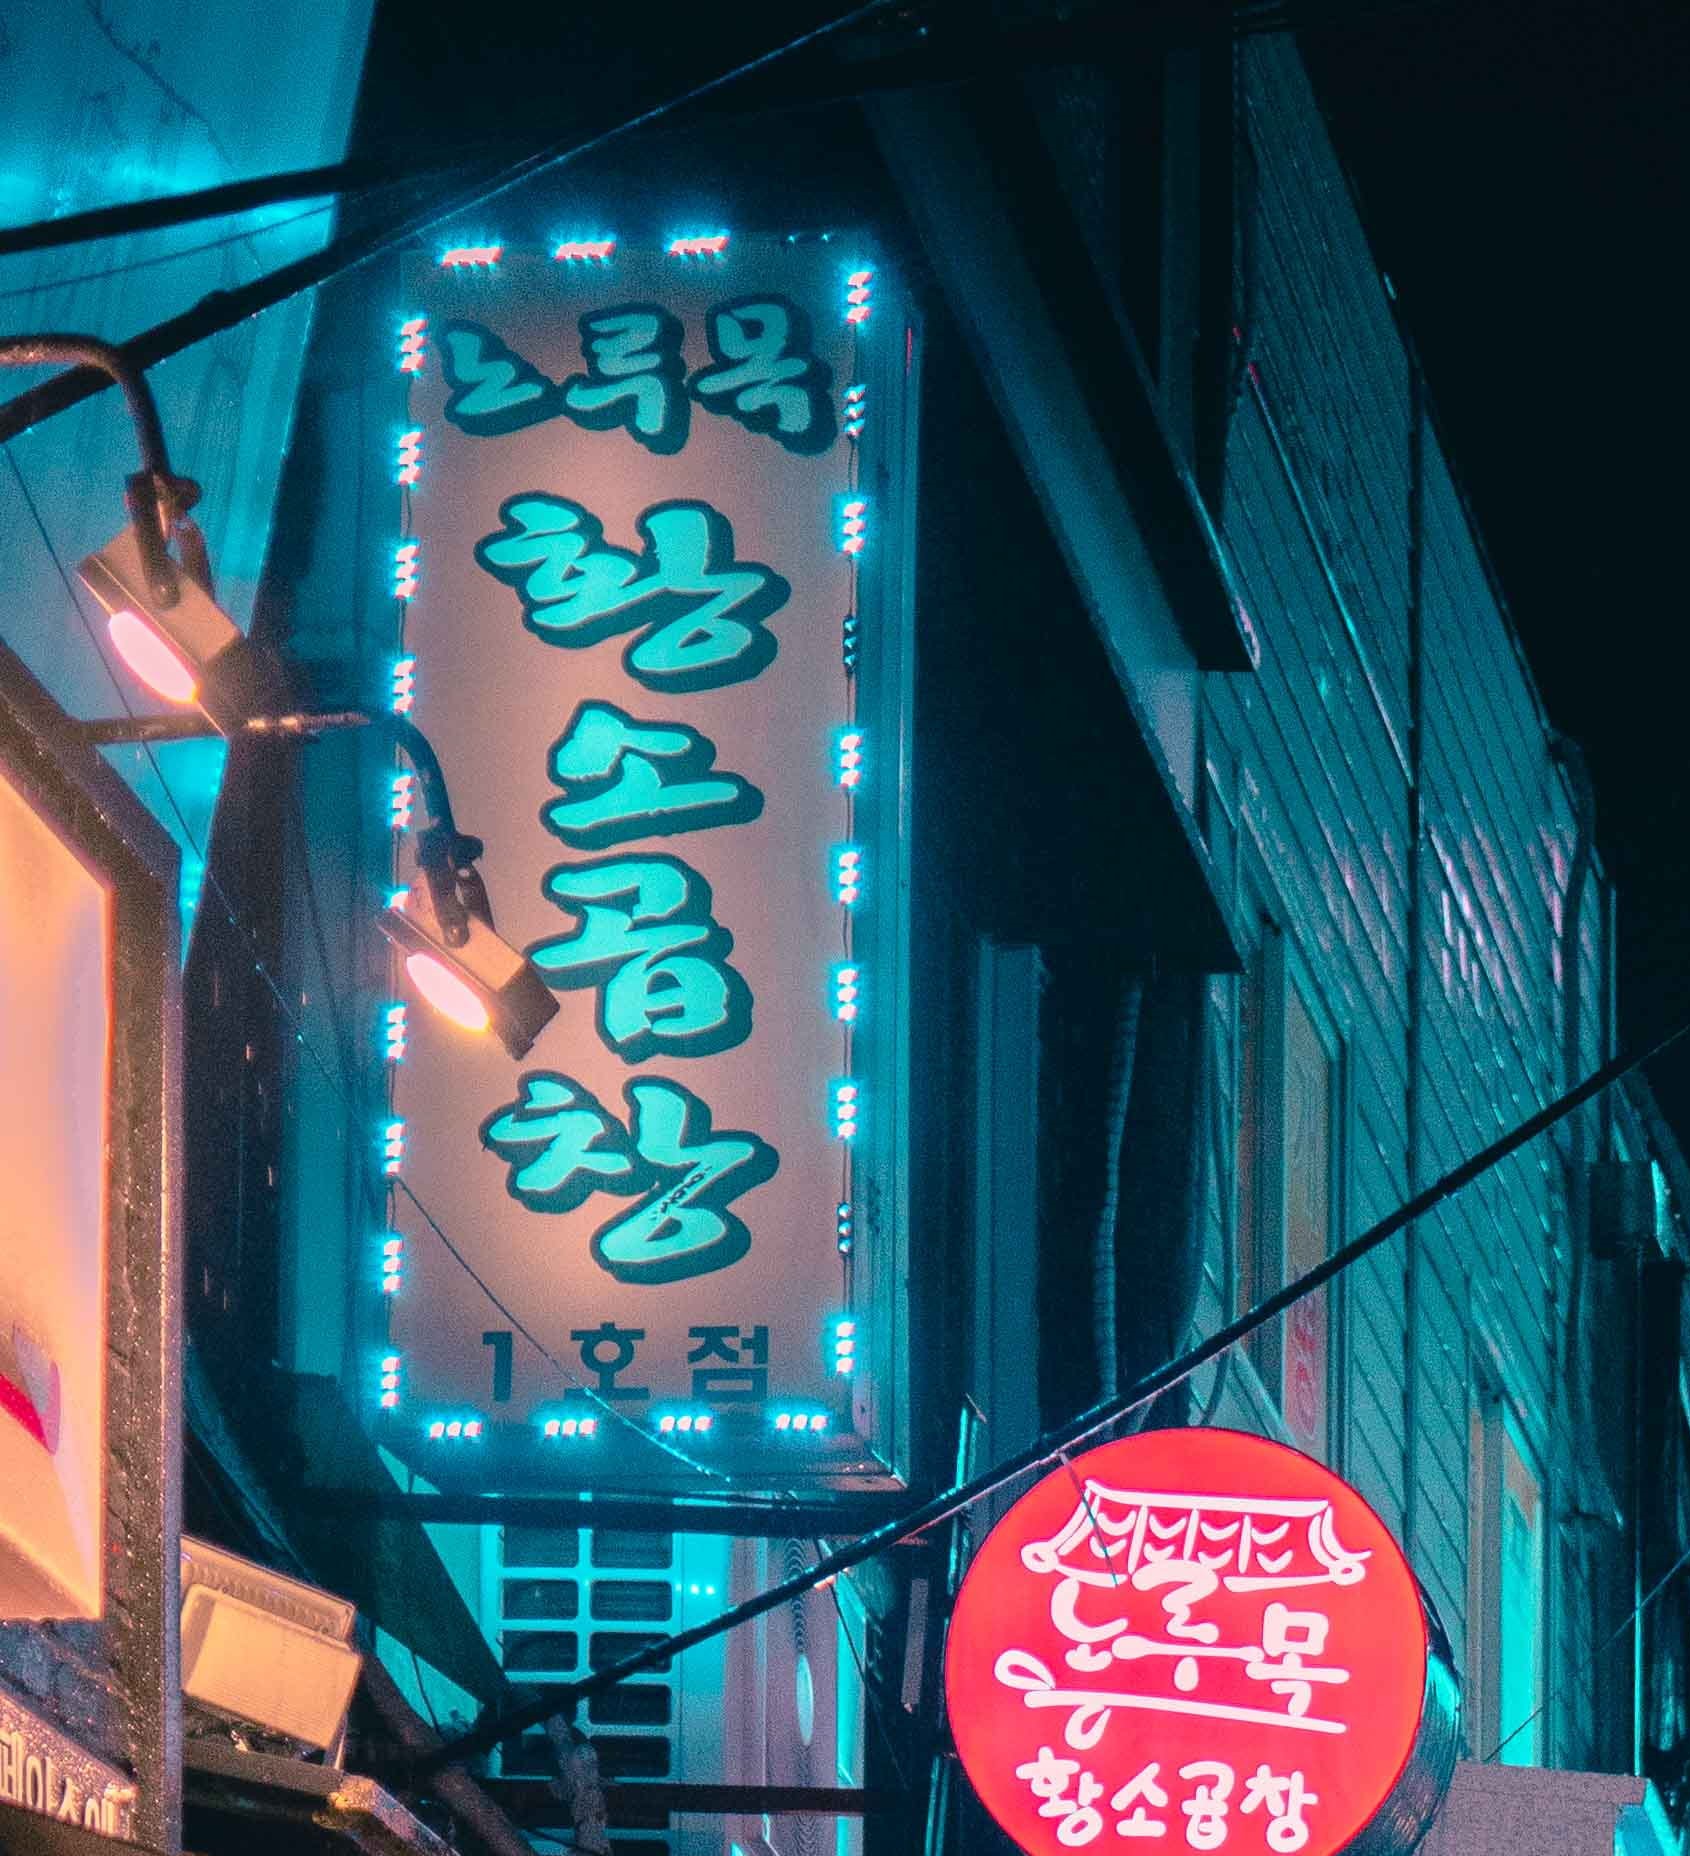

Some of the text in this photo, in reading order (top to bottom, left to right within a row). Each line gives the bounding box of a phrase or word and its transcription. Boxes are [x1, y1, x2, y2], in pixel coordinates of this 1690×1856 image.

[440, 298, 842, 452] 노루목
[476, 492, 792, 1285] 황소곱창
[480, 1325, 772, 1405] 1호점
[1016, 1746, 1319, 1853] 황소곱창
